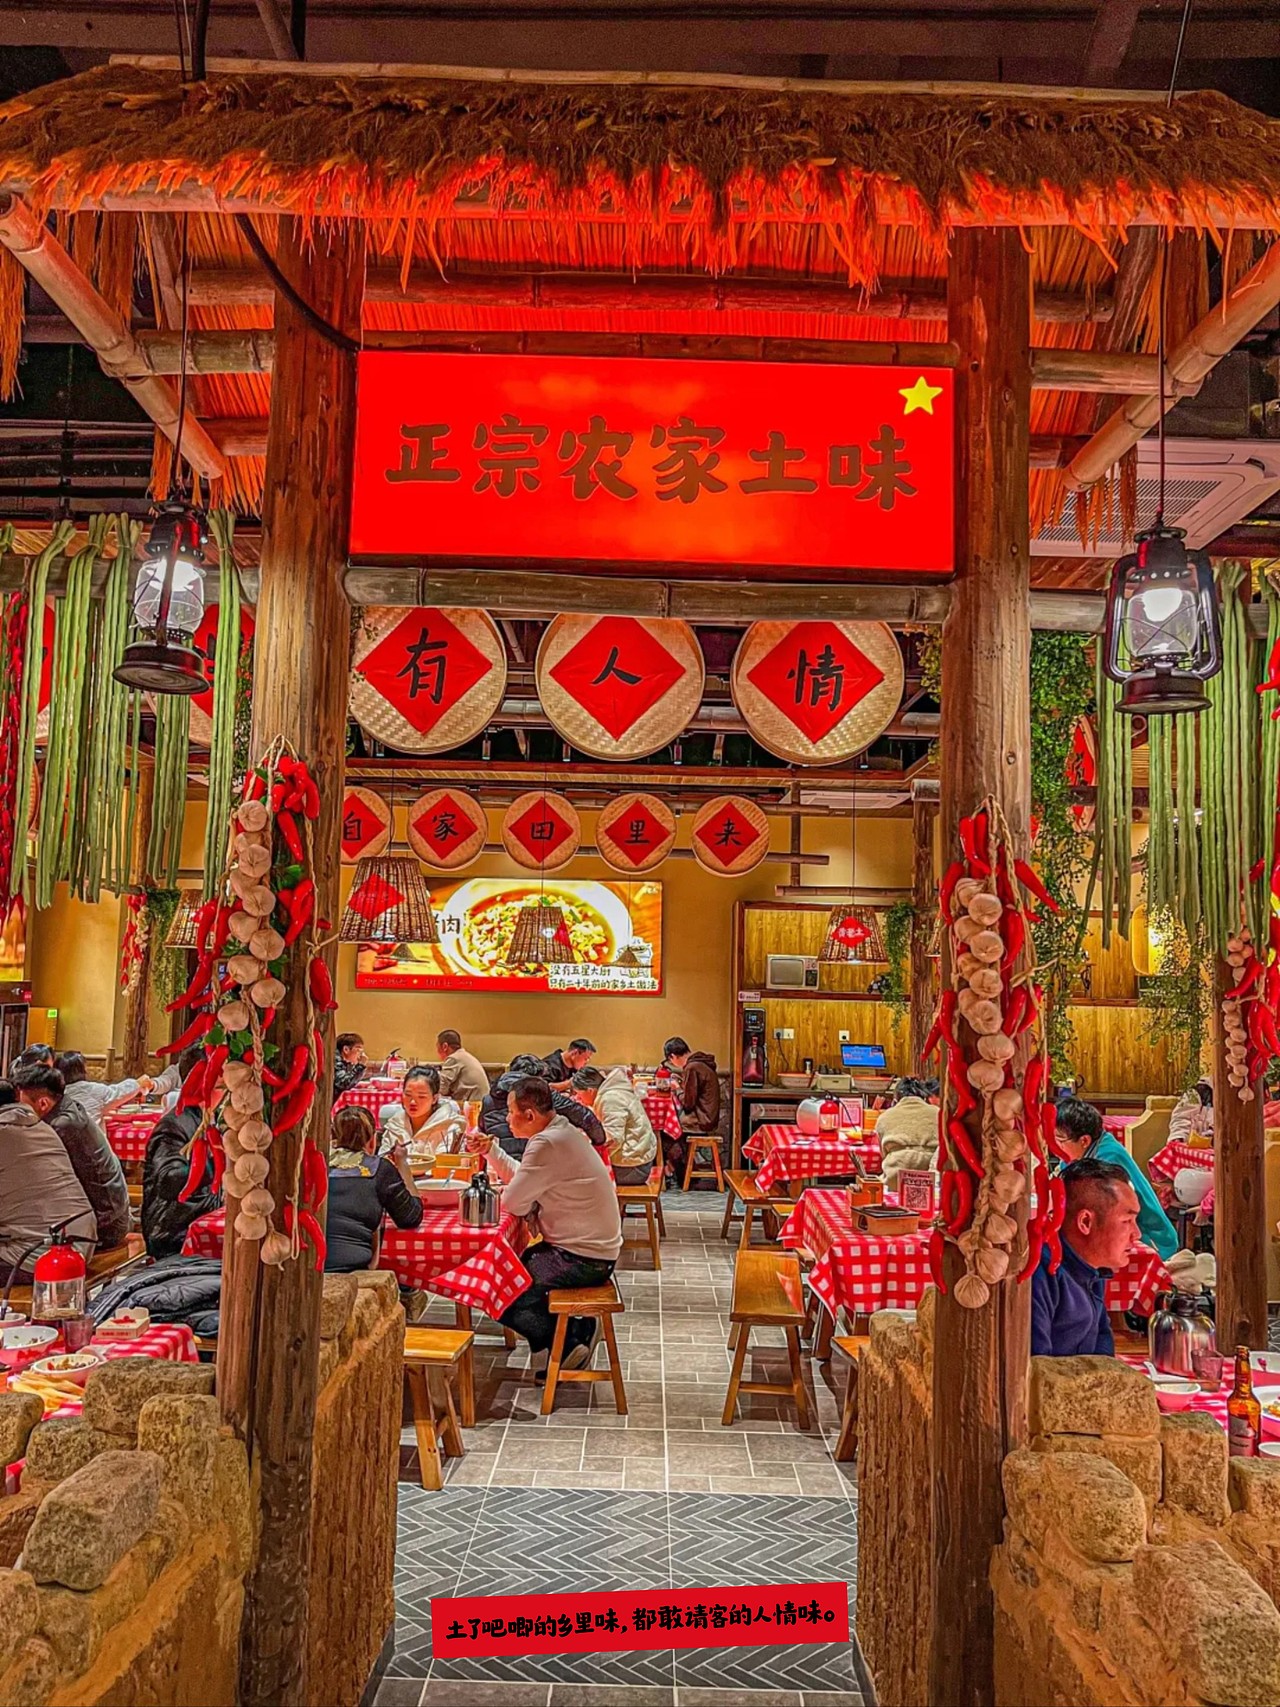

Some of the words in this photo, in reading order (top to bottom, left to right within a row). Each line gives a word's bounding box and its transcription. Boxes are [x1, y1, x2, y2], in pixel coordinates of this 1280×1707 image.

[385, 413, 918, 511] 正宗农家土味
[396, 627, 446, 705] 有
[591, 646, 641, 687] 人
[786, 644, 845, 712] 情
[343, 811, 361, 841] 自
[432, 812, 459, 841] 家
[529, 820, 555, 841] 田
[623, 820, 650, 844] 里
[714, 820, 743, 847] 来
[550, 964, 611, 976] 没有五星大厨
